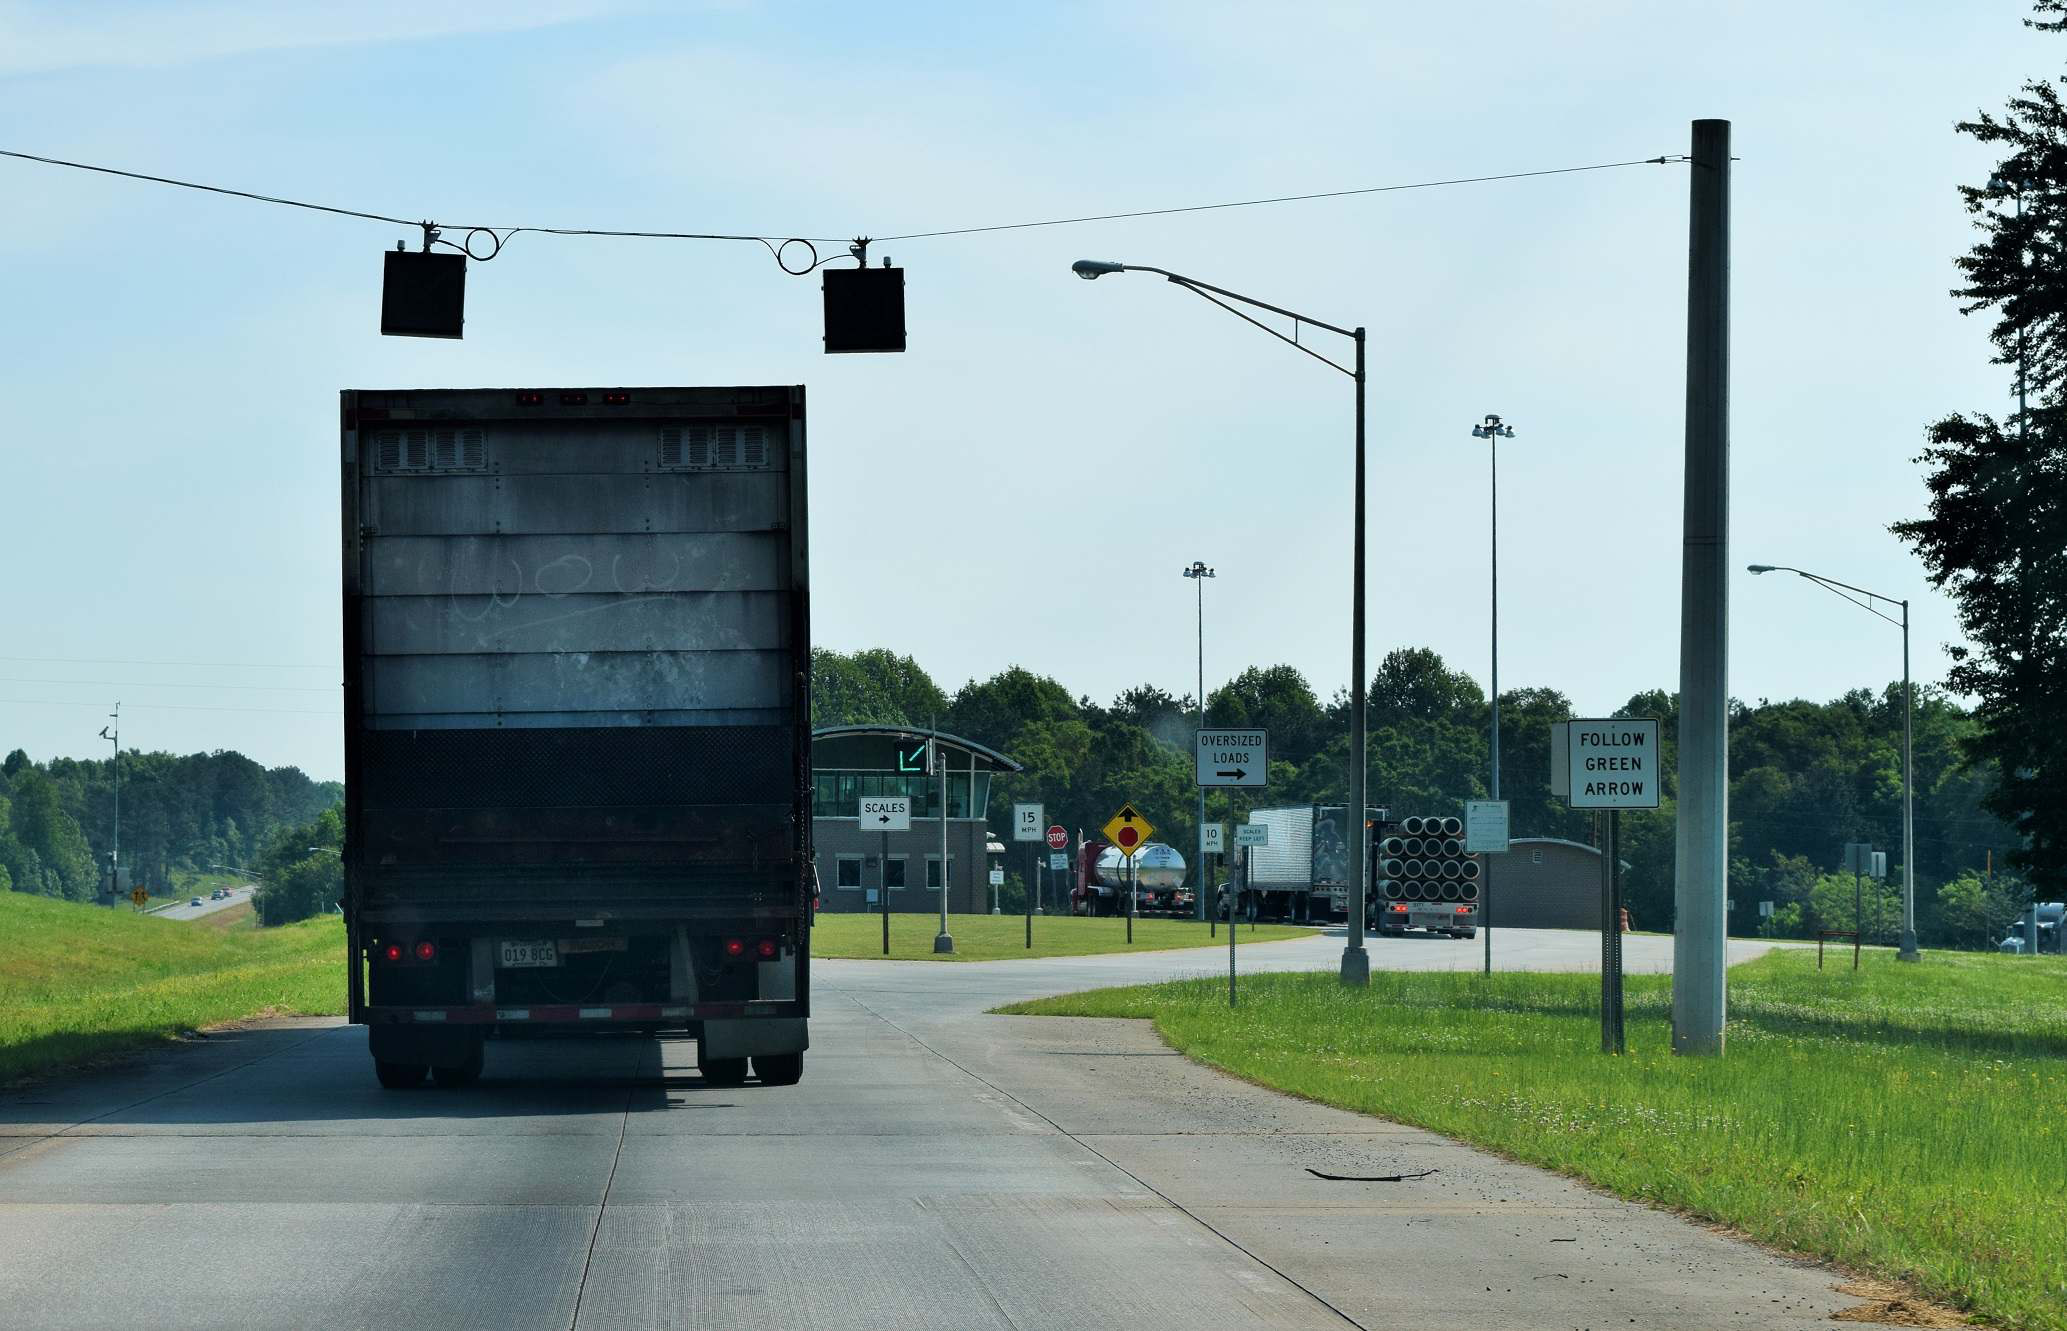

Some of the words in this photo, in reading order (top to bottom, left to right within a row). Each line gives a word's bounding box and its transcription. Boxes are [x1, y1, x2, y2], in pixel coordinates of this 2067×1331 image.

[1201, 735, 1262, 747] OVERSIZED
[1580, 732, 1645, 746] FOLLOW
[1213, 752, 1249, 764] LOADS
[1585, 757, 1642, 771] GREEN
[1584, 782, 1644, 796] ARROW
[864, 803, 905, 813] SCALES
[1022, 812, 1035, 823] 15
[1048, 832, 1066, 842] STOP
[1206, 829, 1217, 838] 10
[504, 948, 527, 962] 019
